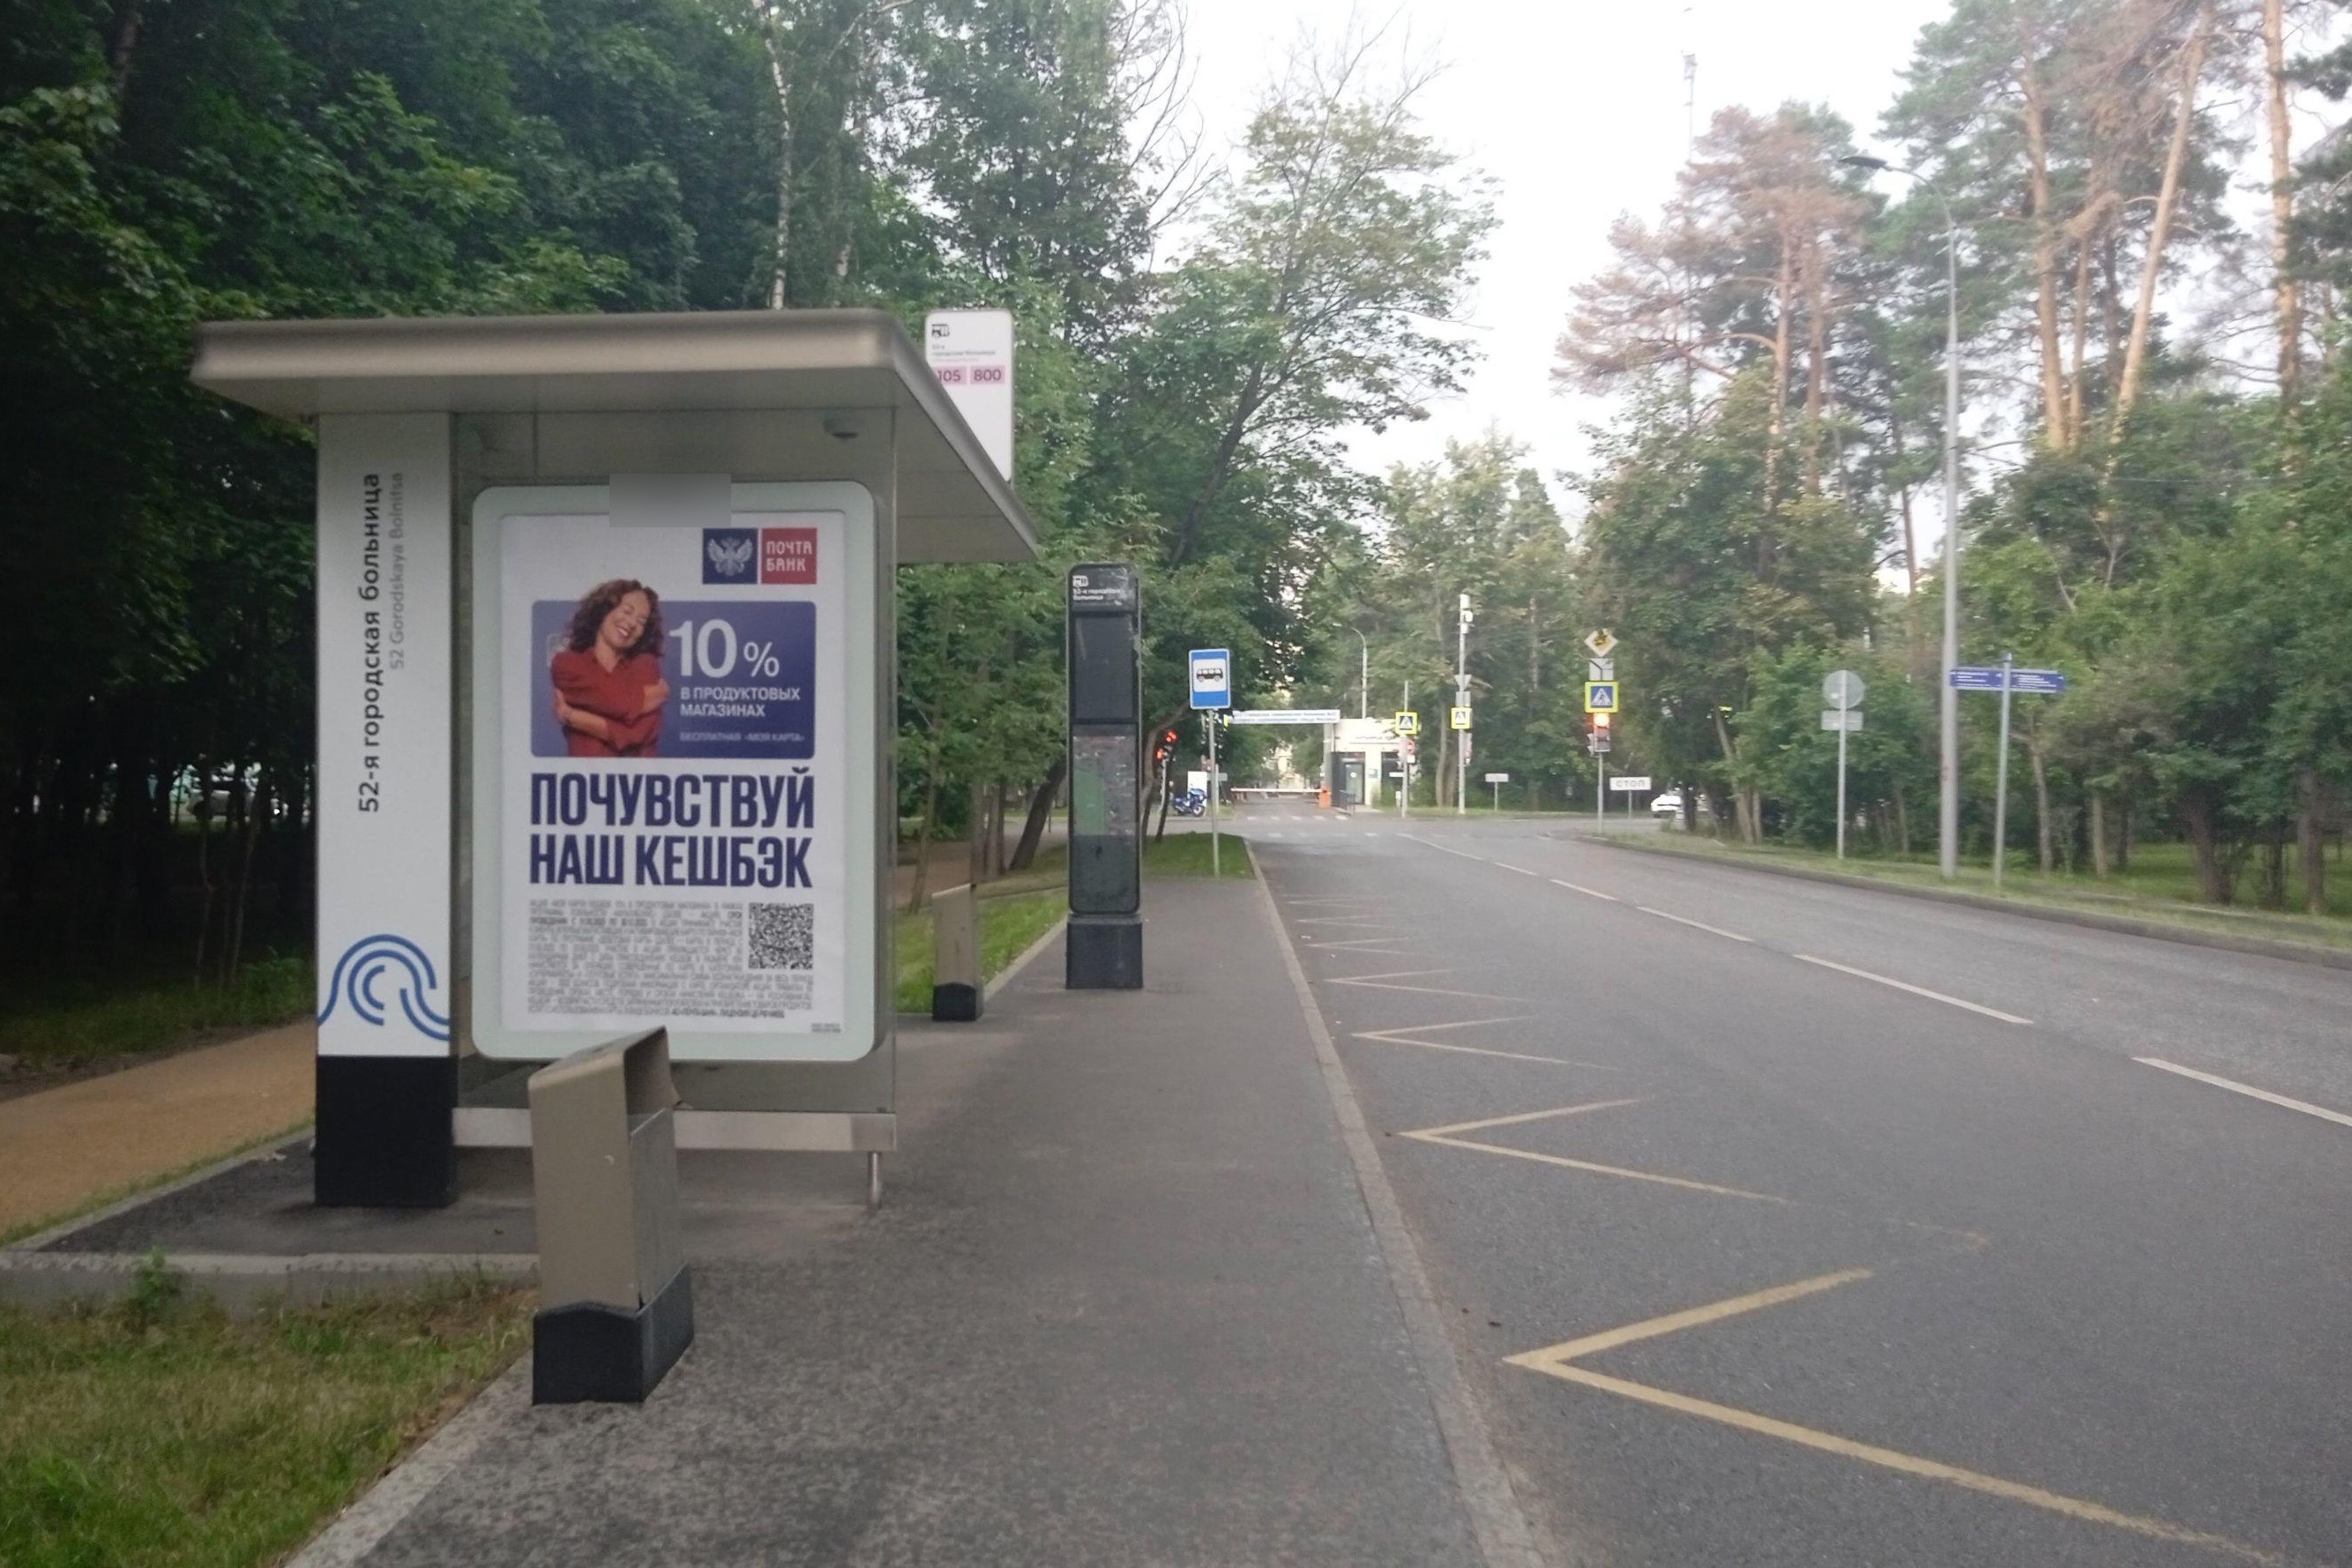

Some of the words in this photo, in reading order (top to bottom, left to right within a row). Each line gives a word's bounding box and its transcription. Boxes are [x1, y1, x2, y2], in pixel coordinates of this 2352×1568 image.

[937, 369, 961, 382] 105
[974, 369, 1002, 382] 800
[389, 472, 404, 539] Bolnitsa
[358, 473, 382, 601] больница
[766, 541, 813, 556] ПОЧТА
[766, 557, 806, 571] БАНК
[389, 544, 406, 644] Gorodskaya
[390, 648, 404, 669] 52
[668, 619, 737, 678] 10
[743, 642, 780, 677] %
[364, 611, 384, 747] городская
[681, 687, 691, 700] В
[693, 687, 800, 701] ПРОДУКТОВЫХ
[680, 704, 765, 717] МАГАЗИНАХ
[358, 756, 379, 812] 52-я
[531, 766, 815, 829] ПОЧУВСТВУЙ
[531, 834, 624, 885] НАШ
[635, 835, 813, 888] КЕШБЭК
